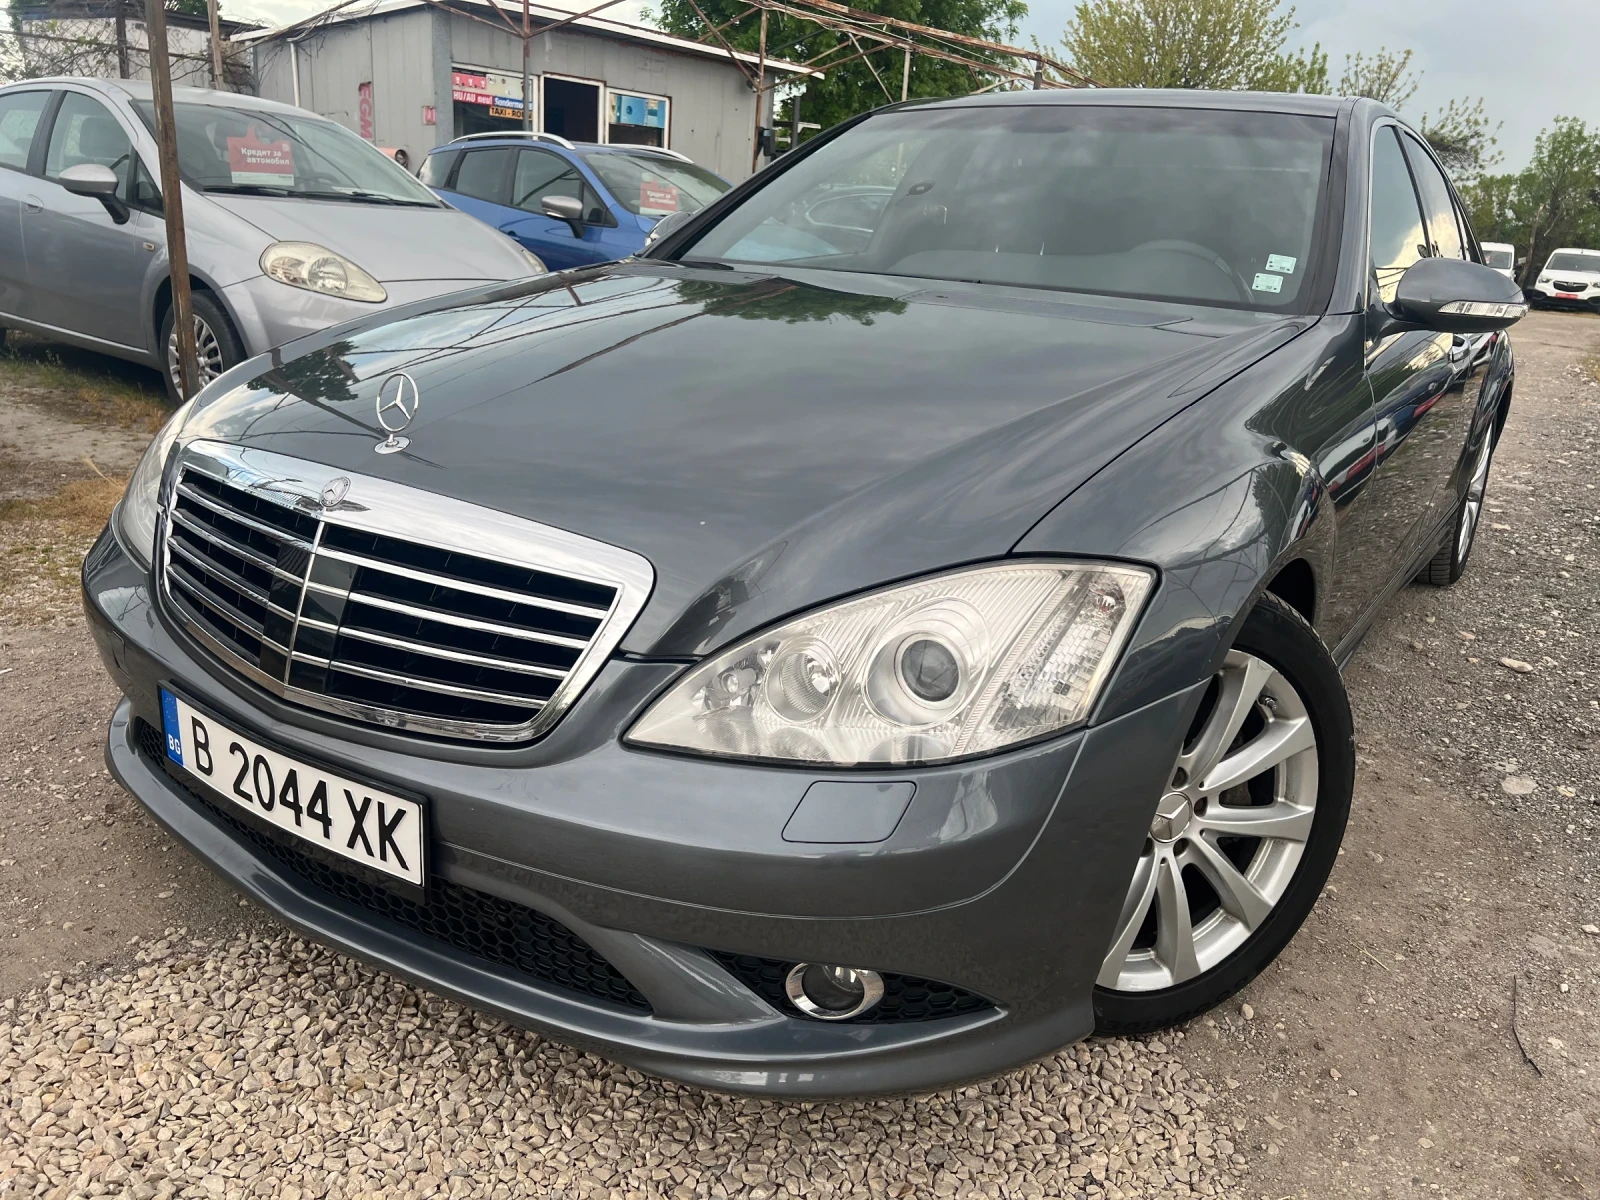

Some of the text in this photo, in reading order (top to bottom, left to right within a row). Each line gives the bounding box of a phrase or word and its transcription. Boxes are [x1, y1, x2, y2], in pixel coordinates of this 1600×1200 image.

[453, 90, 476, 102] HU/AU
[491, 107, 507, 116] TAXI
[241, 147, 271, 157] Кредит
[246, 156, 290, 165] автомобил
[168, 733, 181, 755] BG
[191, 715, 410, 872] B 2044 XK
